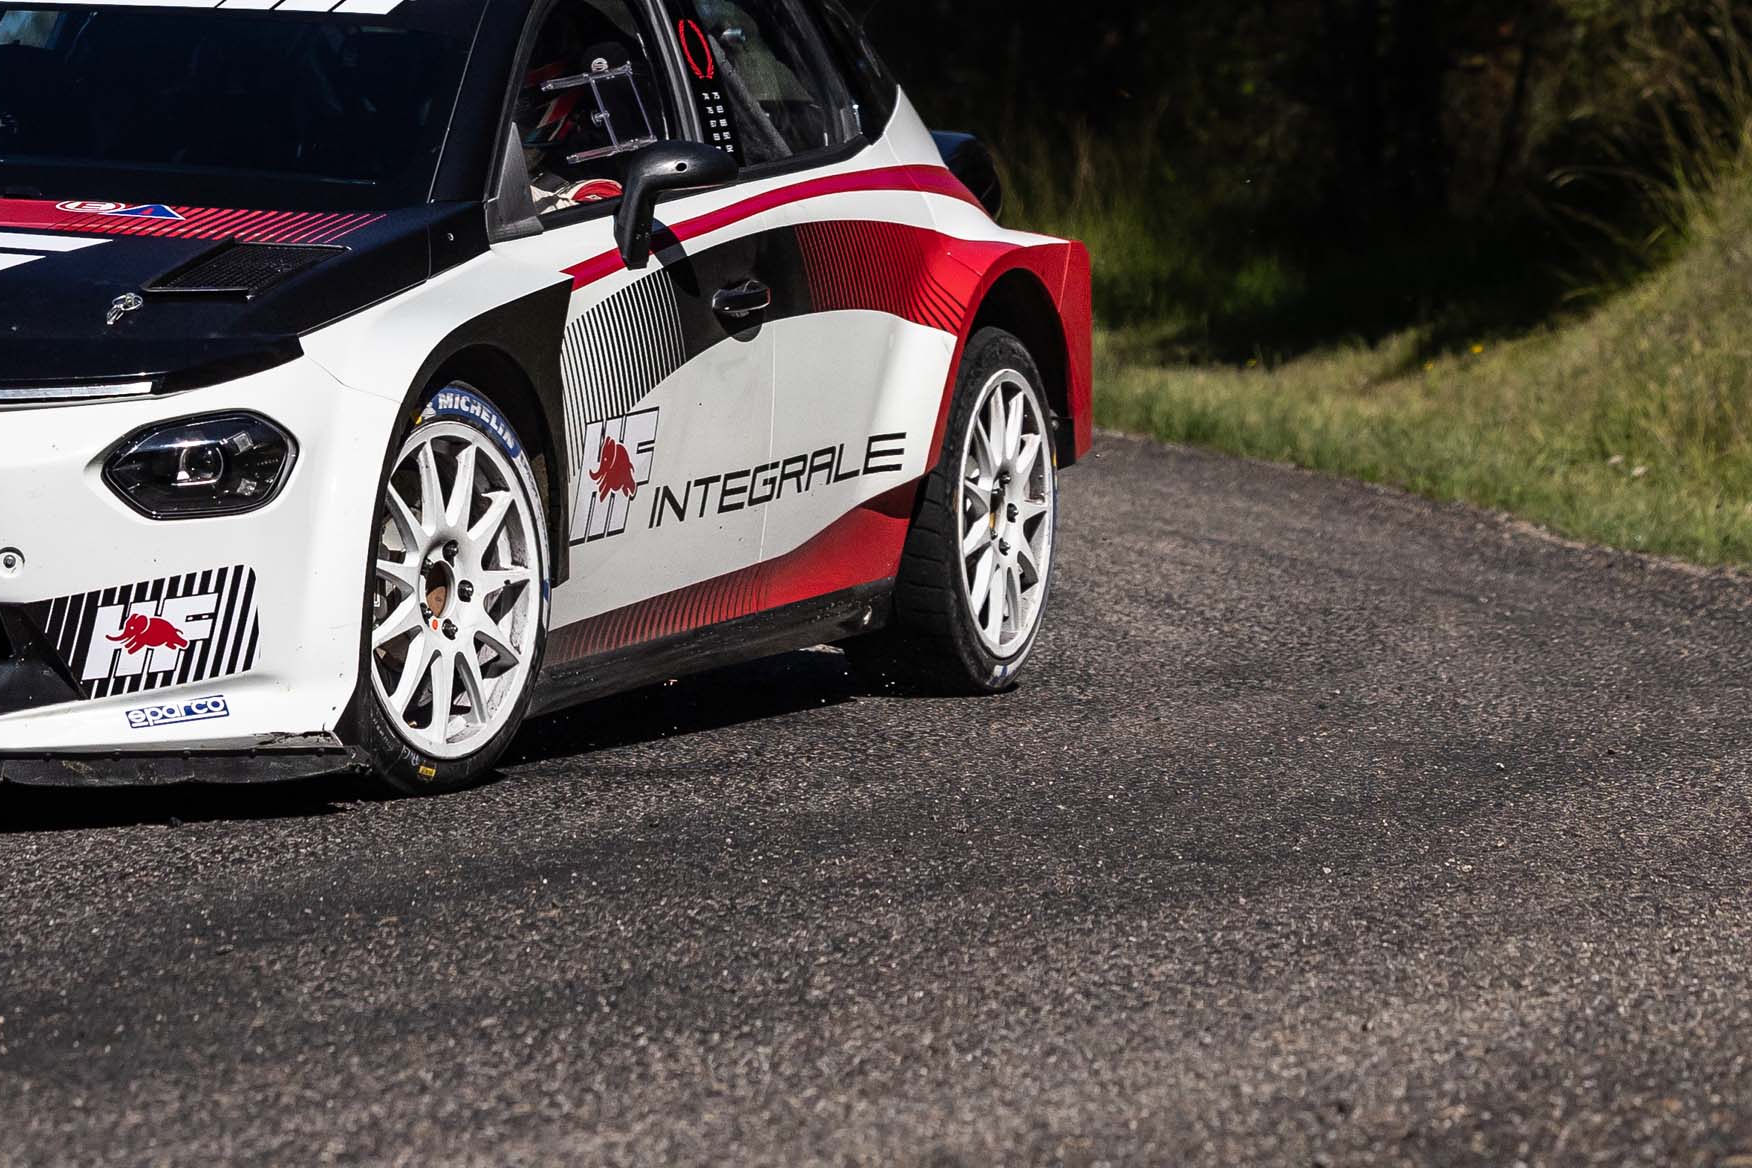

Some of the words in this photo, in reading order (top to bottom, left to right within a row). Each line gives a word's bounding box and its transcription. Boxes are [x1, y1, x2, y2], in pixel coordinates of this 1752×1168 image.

[437, 392, 515, 449] MICHELIN
[647, 432, 907, 529] INTEGRALE
[127, 696, 226, 726] sparco
